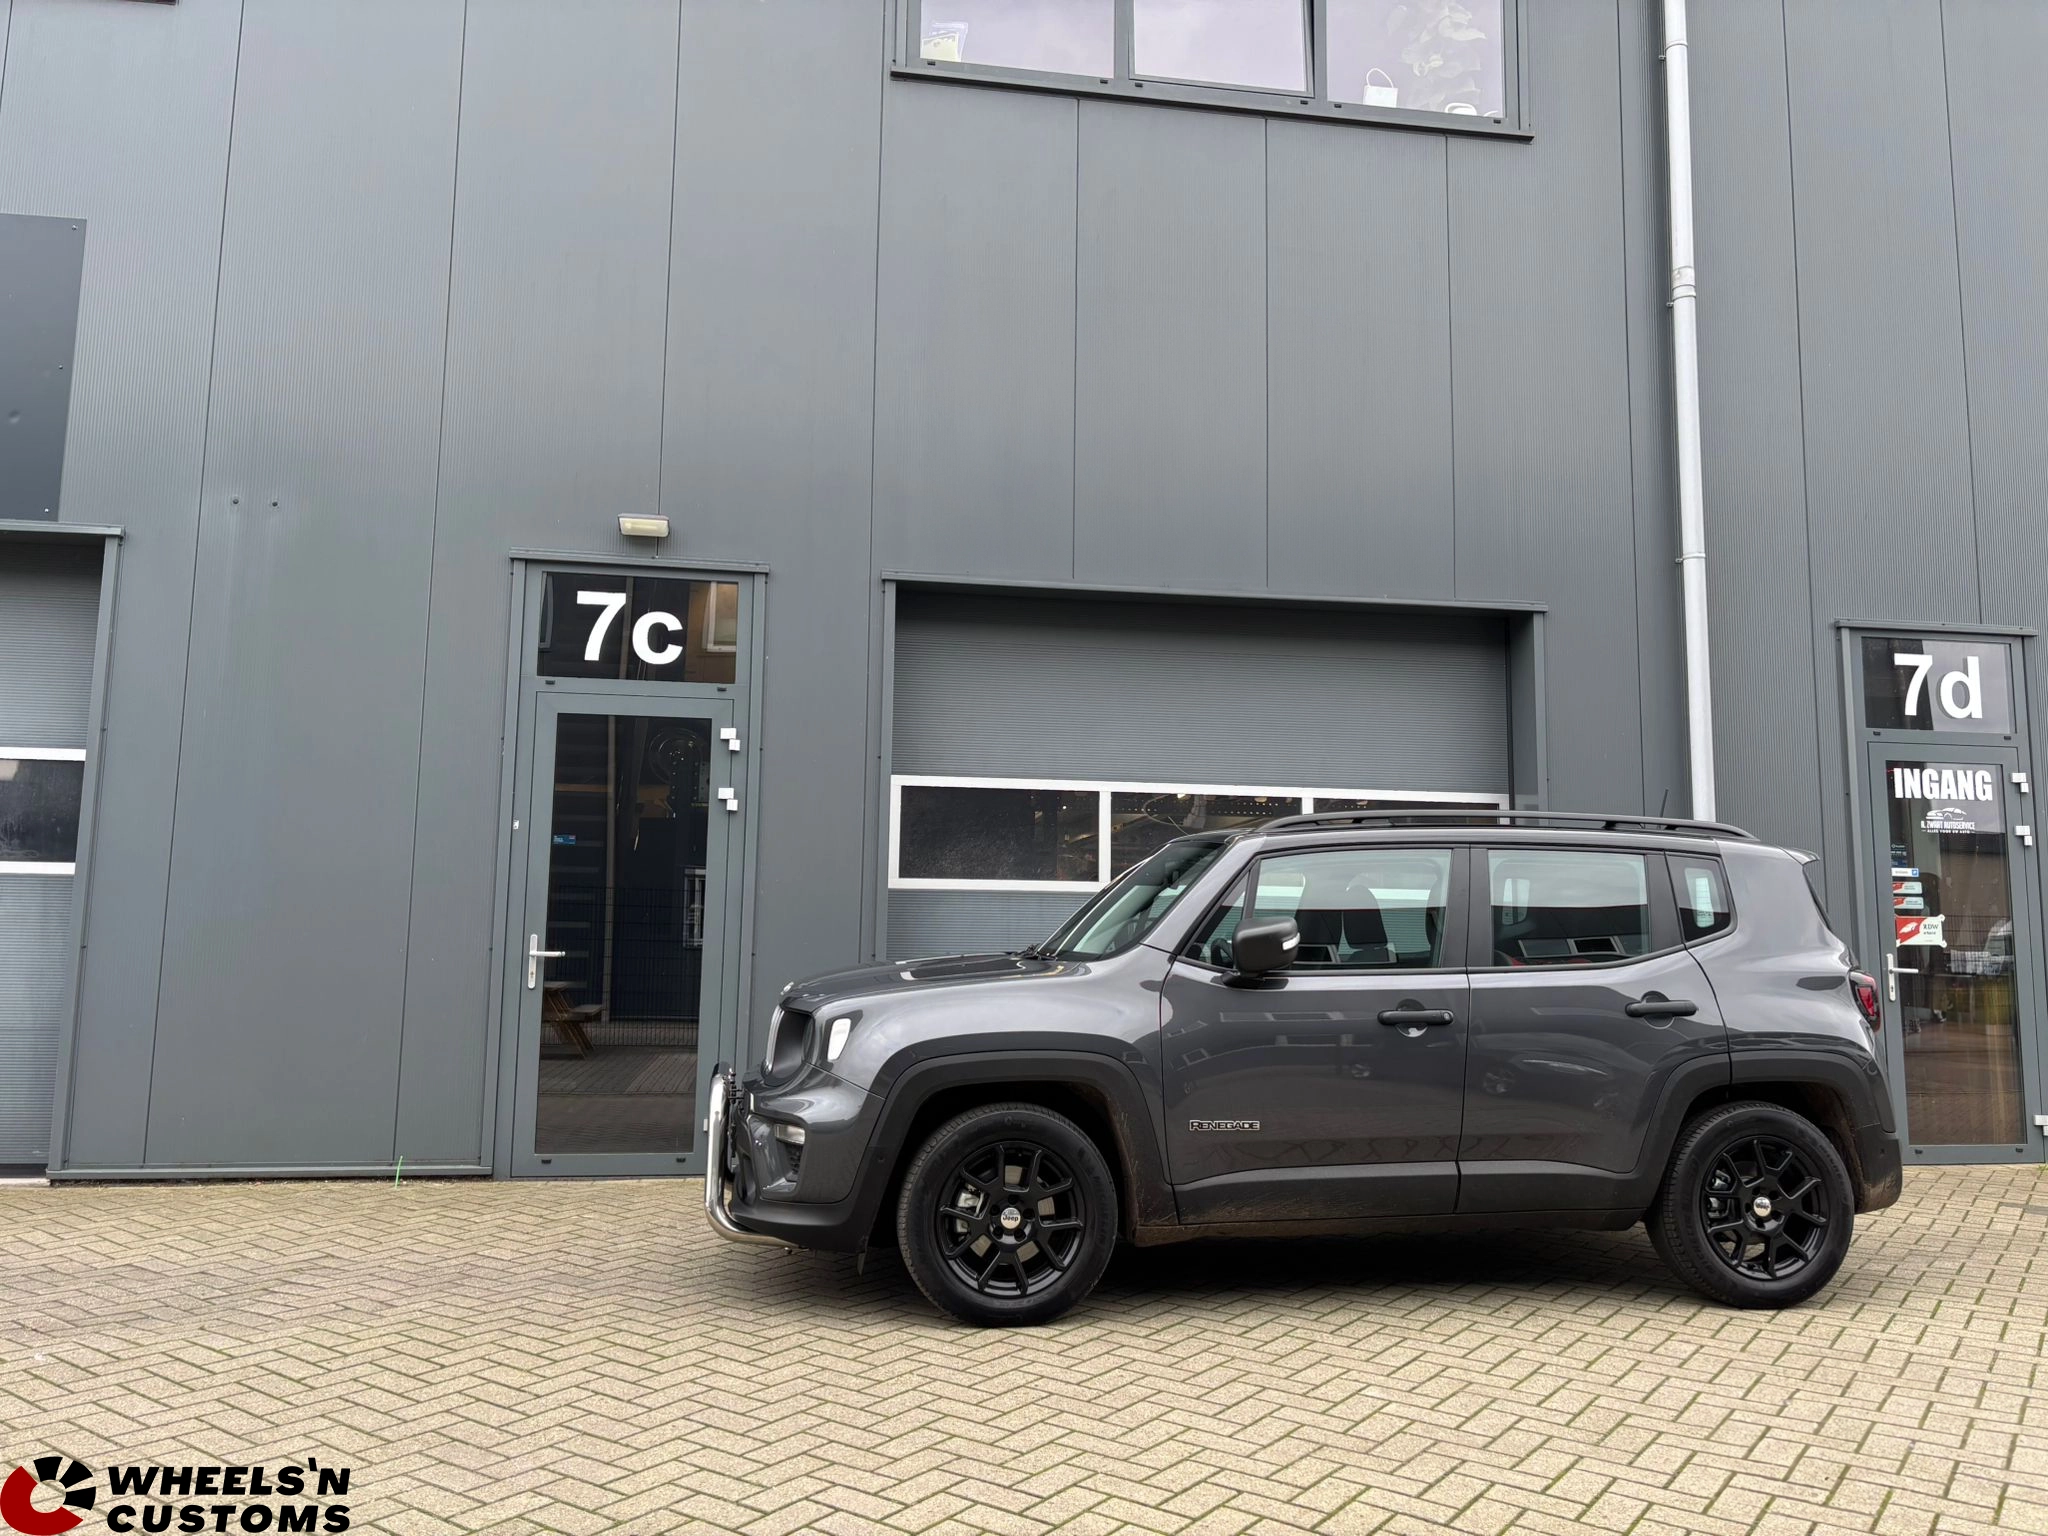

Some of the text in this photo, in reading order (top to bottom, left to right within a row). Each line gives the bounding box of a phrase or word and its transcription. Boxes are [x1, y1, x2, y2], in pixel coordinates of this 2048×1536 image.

[577, 590, 683, 665] 7c
[1894, 653, 1983, 719] 7d
[1893, 767, 1993, 801] INGANG
[1944, 821, 1976, 830] AUTOSERVICE
[1190, 1120, 1260, 1131] RENEGADE
